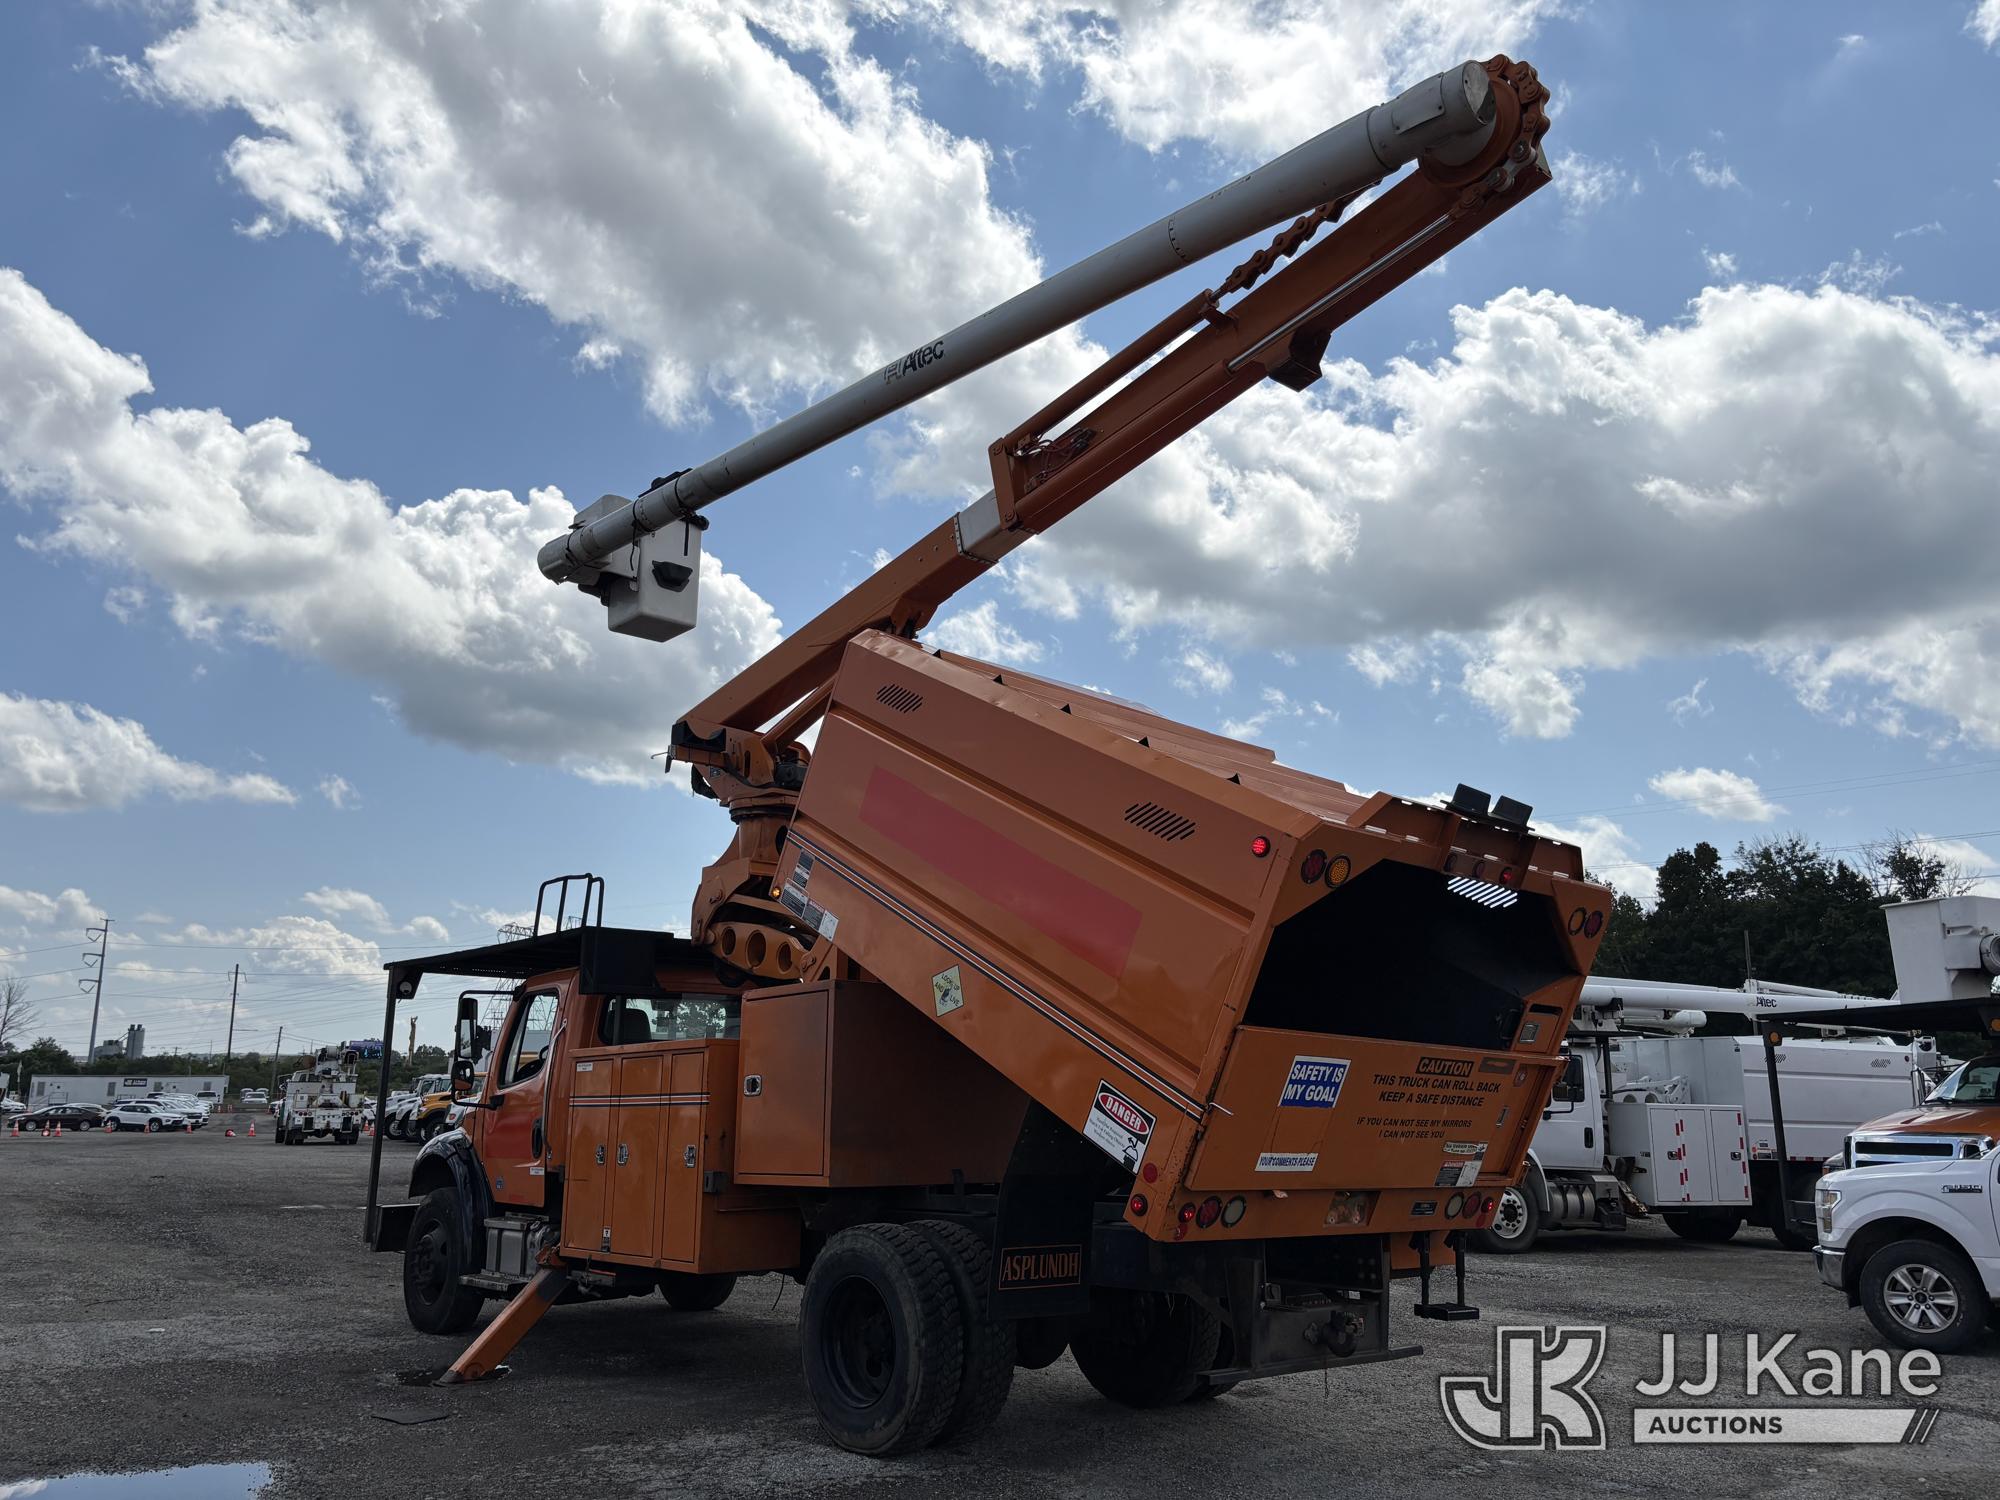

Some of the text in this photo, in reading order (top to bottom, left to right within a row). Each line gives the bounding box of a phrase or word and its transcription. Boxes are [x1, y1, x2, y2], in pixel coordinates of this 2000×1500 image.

[902, 340, 944, 376] Altec
[1756, 996, 1776, 1008] Altec
[1291, 1064, 1344, 1082] SAFETY IS
[1418, 1058, 1472, 1075] CAUTION
[1373, 1074, 1501, 1093] THIS TRUCK CAN ROLL BACK
[1284, 1084, 1336, 1102] MY GOAL
[1379, 1091, 1485, 1106] KEEP A SAFE DISTANCE
[1106, 1096, 1142, 1131] DANGER
[1366, 1117, 1382, 1125] YOU
[1383, 1118, 1399, 1126] CAN
[1415, 1119, 1429, 1127] SEE
[1442, 1120, 1472, 1128] MIRRORS
[1272, 1156, 1298, 1166] COMMENTS
[1297, 1156, 1316, 1166] PLEASE
[1001, 1252, 1080, 1281] ASPLUNDH
